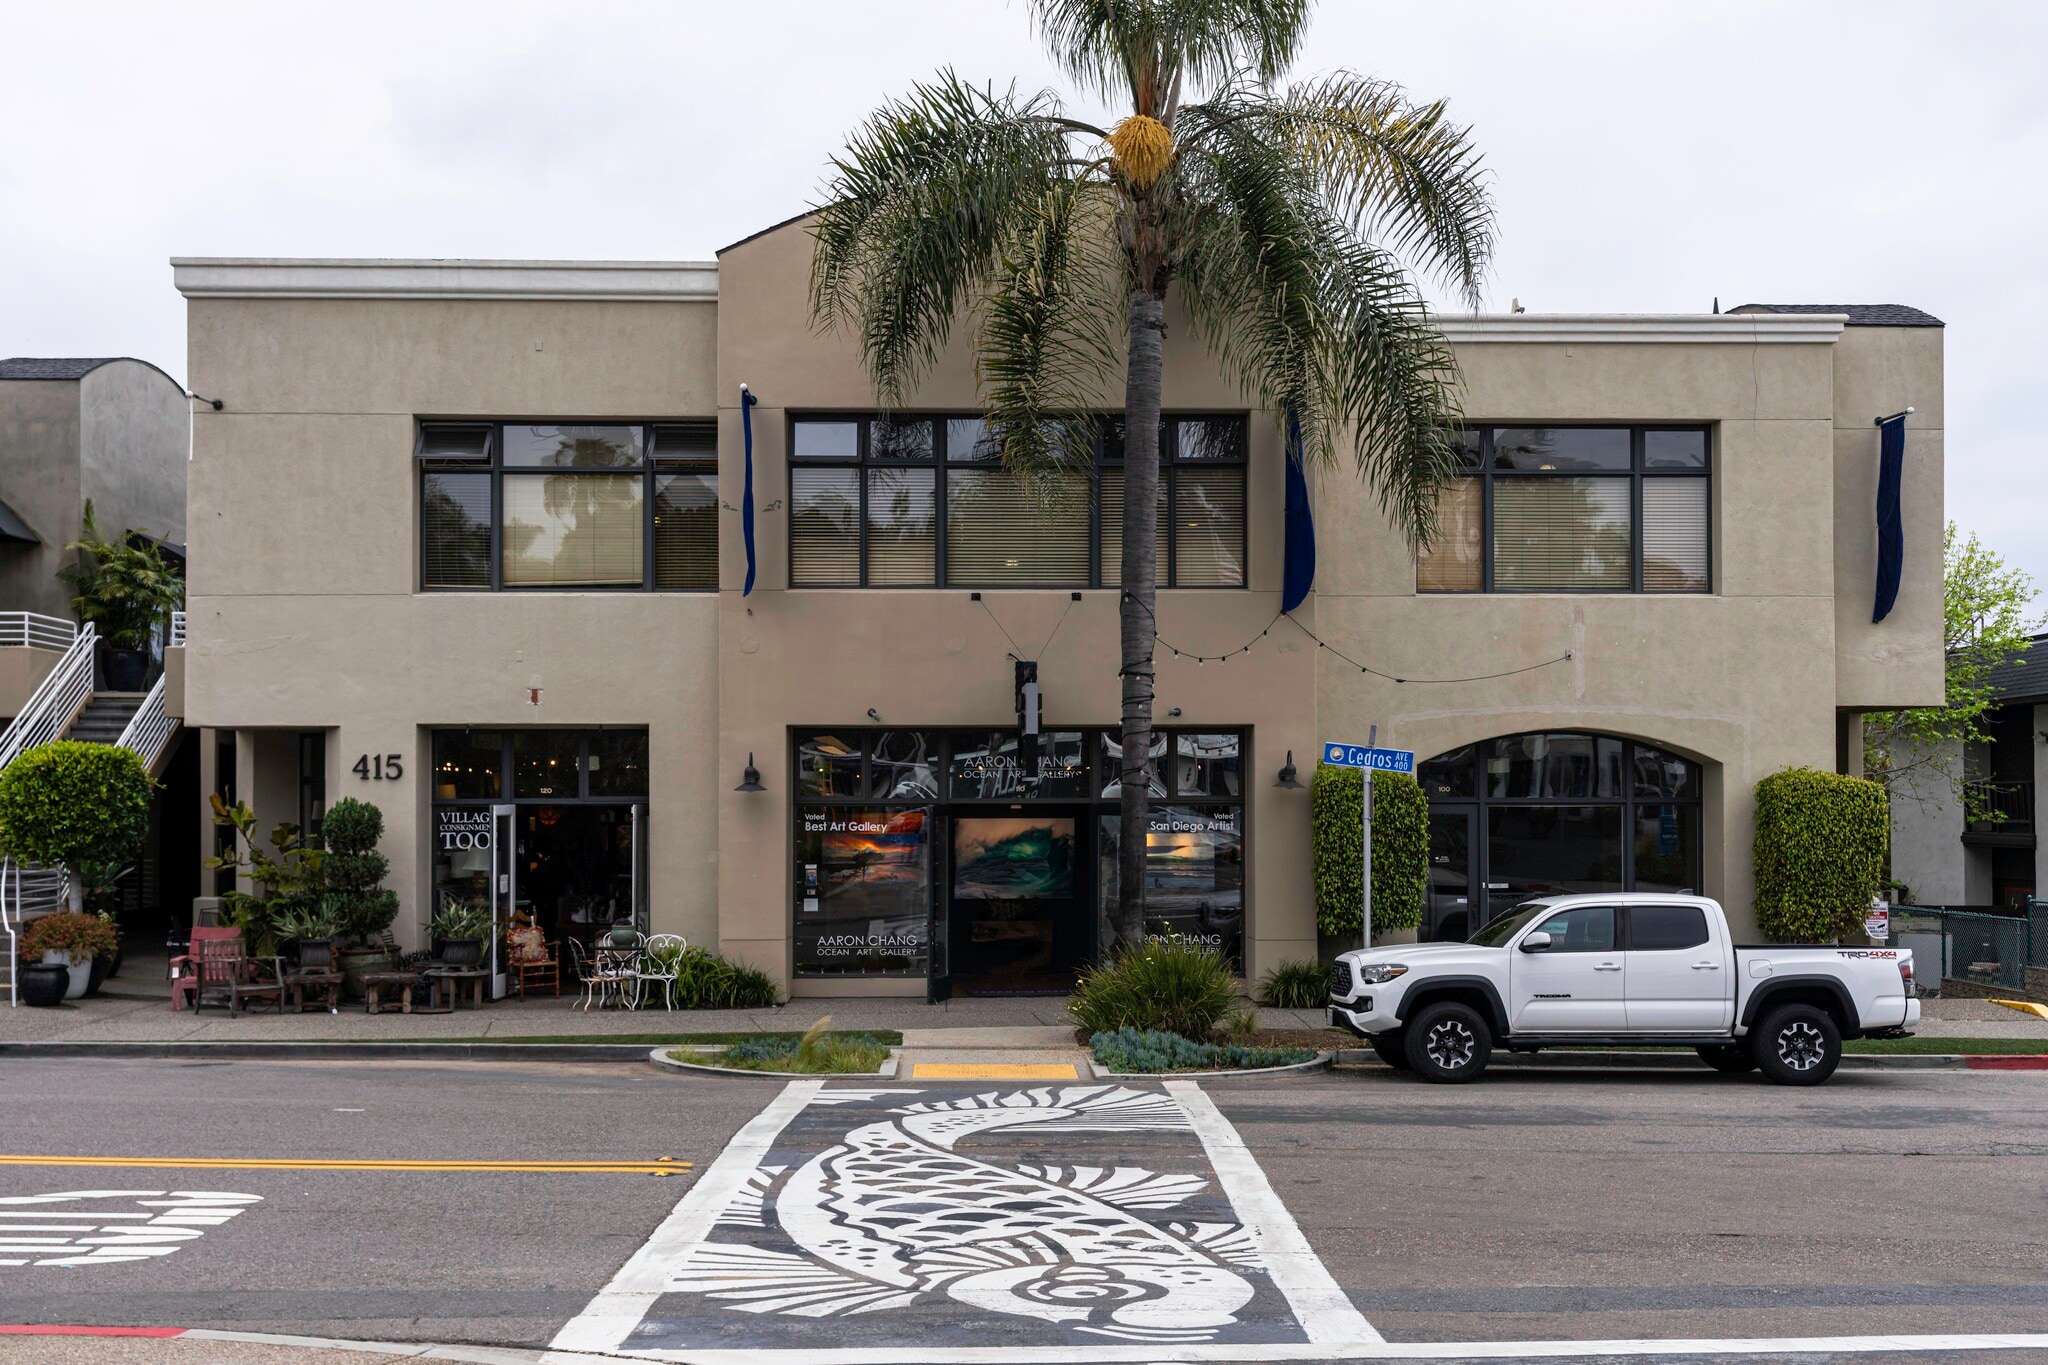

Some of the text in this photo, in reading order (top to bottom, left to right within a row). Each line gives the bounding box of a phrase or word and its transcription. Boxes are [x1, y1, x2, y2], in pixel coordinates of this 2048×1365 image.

[963, 755, 1075, 767] AARON ANG
[1348, 748, 1409, 768] Cedros AVE
[352, 753, 403, 780] 415
[1393, 761, 1408, 771] 400
[963, 771, 1000, 779] OCEAN
[1008, 771, 1022, 779] AR
[440, 812, 490, 823] VILLAG
[805, 821, 888, 834] Best Art Gallery
[1150, 821, 1234, 833] San Diego Artist
[817, 935, 917, 946] AARON CHANG
[1144, 934, 1222, 945] RON CHANG
[816, 948, 917, 956] OCEAN ART GALLERY
